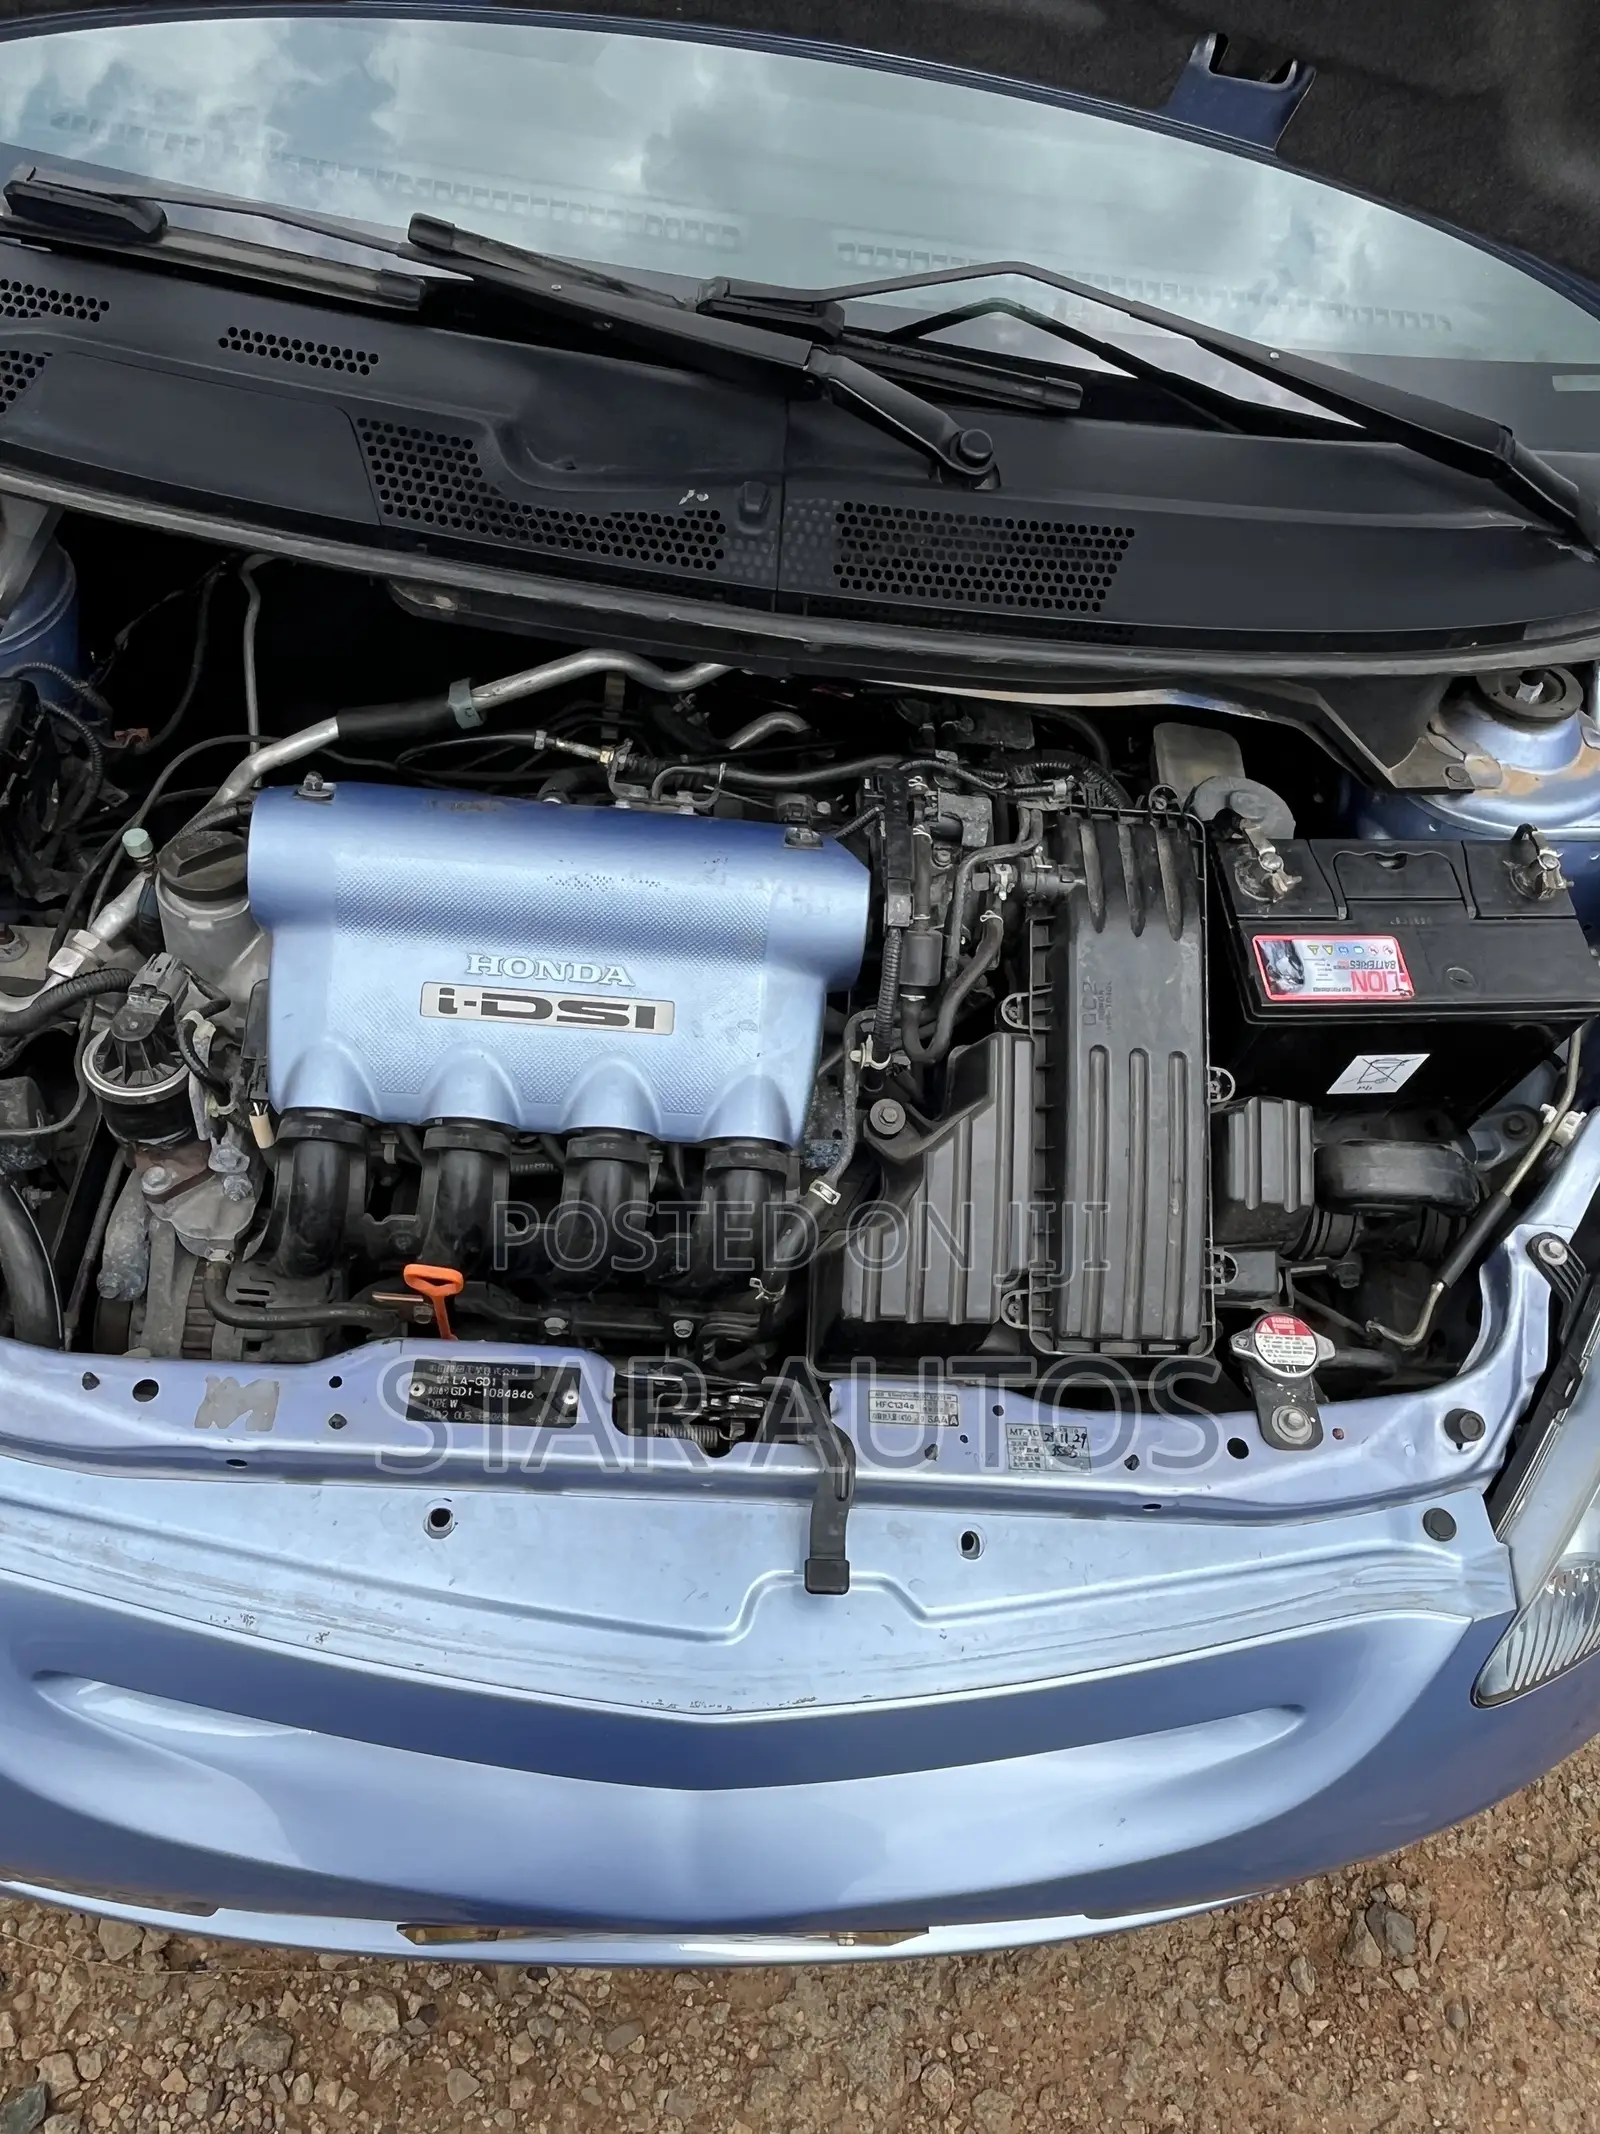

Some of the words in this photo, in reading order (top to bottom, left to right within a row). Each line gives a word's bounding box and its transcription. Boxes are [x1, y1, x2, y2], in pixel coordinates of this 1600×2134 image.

[466, 952, 636, 987] HONDA
[1350, 960, 1396, 970] BATTERIES
[1351, 971, 1400, 992] LION
[438, 987, 656, 1030] i-DSI
[452, 1375, 496, 1386] LA-GD1
[450, 1386, 535, 1400] GD1-1084846
[427, 1399, 447, 1408] TYPE
